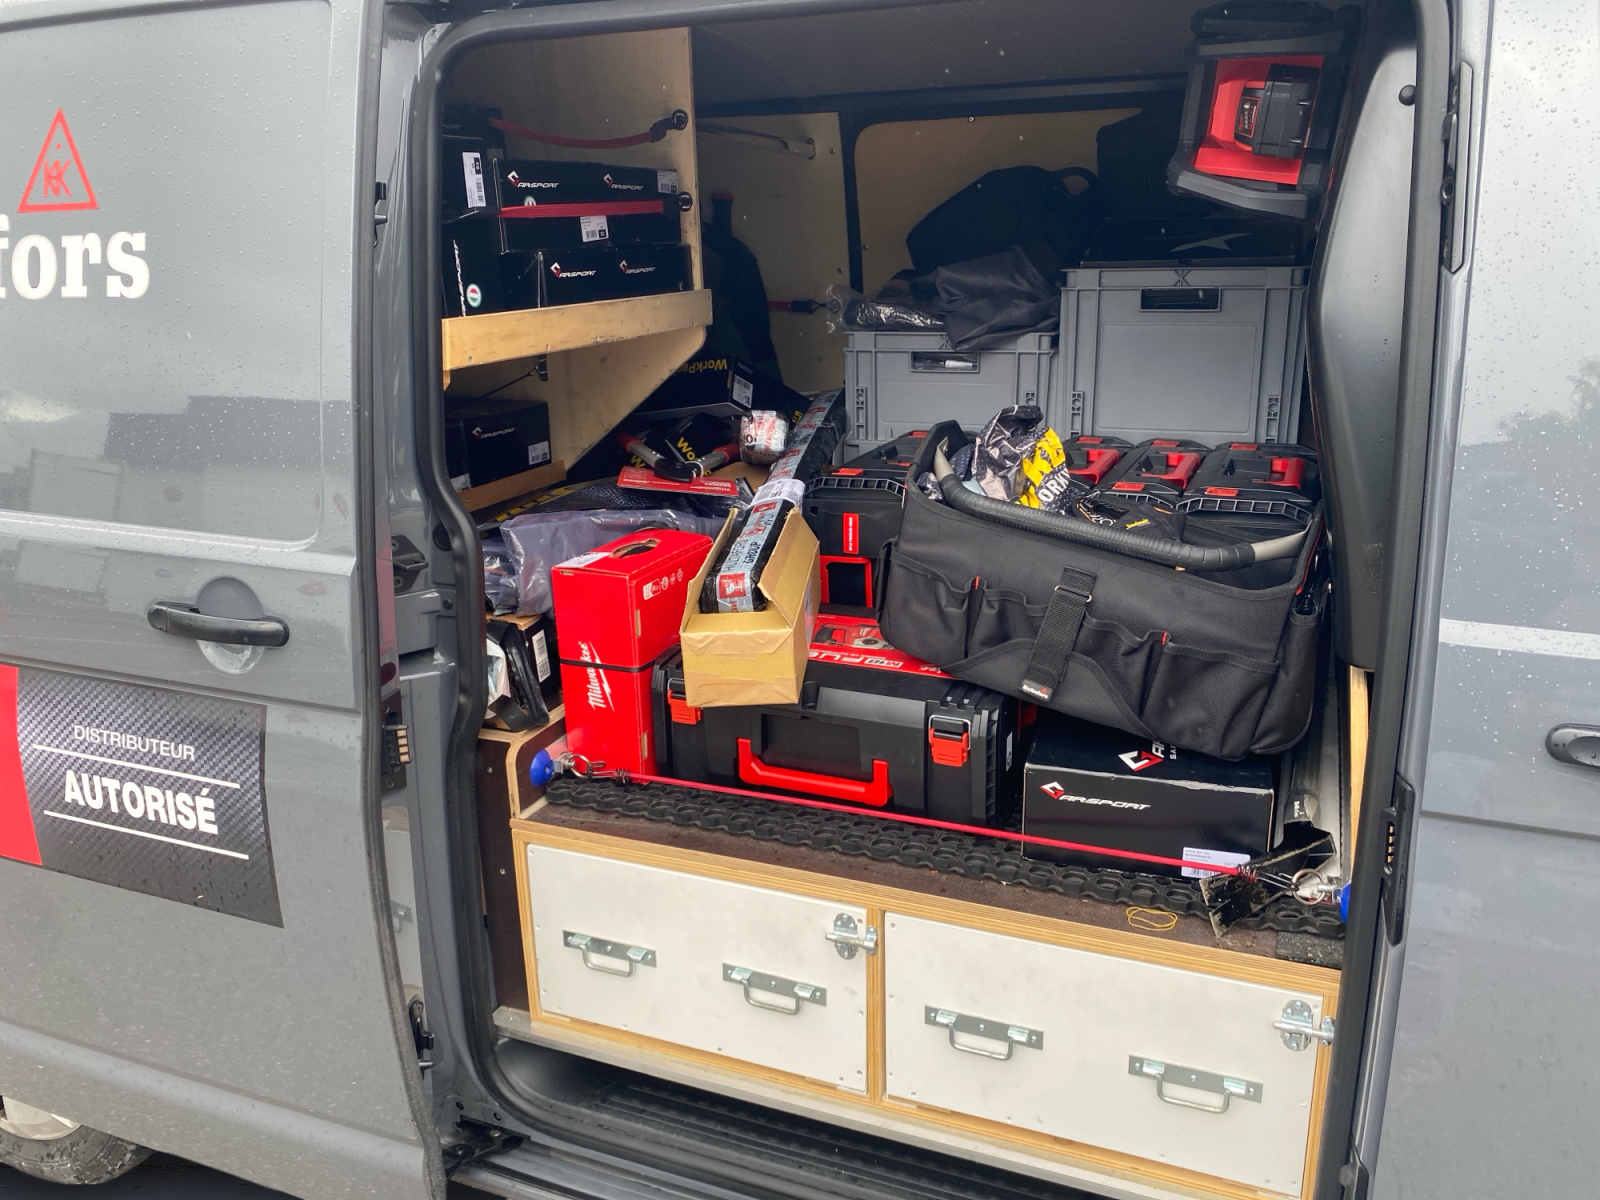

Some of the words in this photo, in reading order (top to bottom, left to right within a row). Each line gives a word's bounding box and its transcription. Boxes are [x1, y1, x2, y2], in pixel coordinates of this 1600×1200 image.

[579, 642, 607, 711] Milwakee
[74, 724, 195, 762] DISTRIBUTEUR
[63, 770, 219, 835] AUTORISÉ
